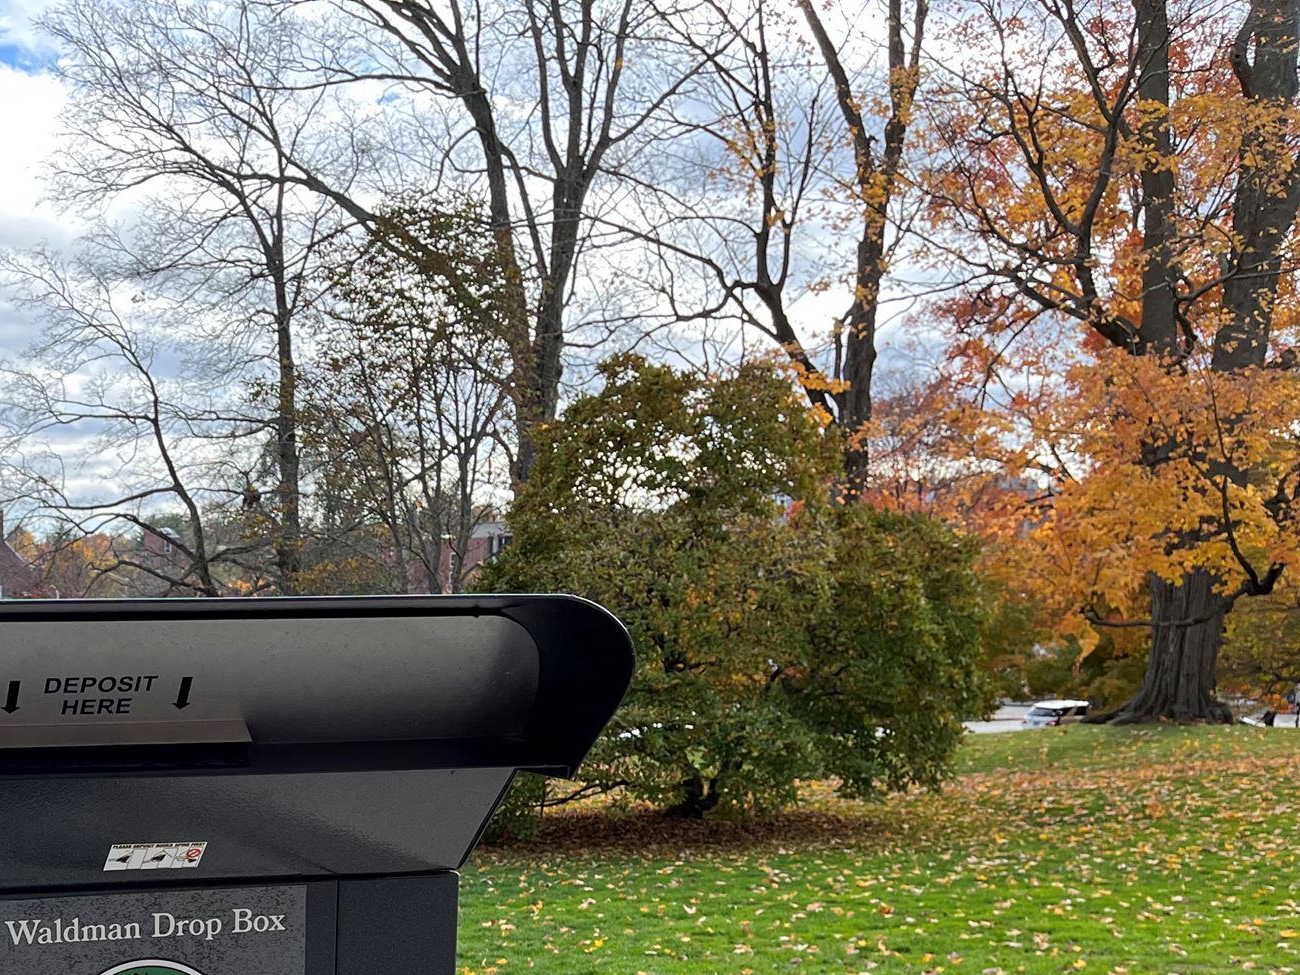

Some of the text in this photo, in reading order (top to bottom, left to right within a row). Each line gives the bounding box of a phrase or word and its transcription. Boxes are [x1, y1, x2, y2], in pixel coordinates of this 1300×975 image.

[43, 675, 159, 694] DEPOSIT
[61, 698, 132, 715] HERE
[4, 908, 286, 946] Waldman Drop Box
